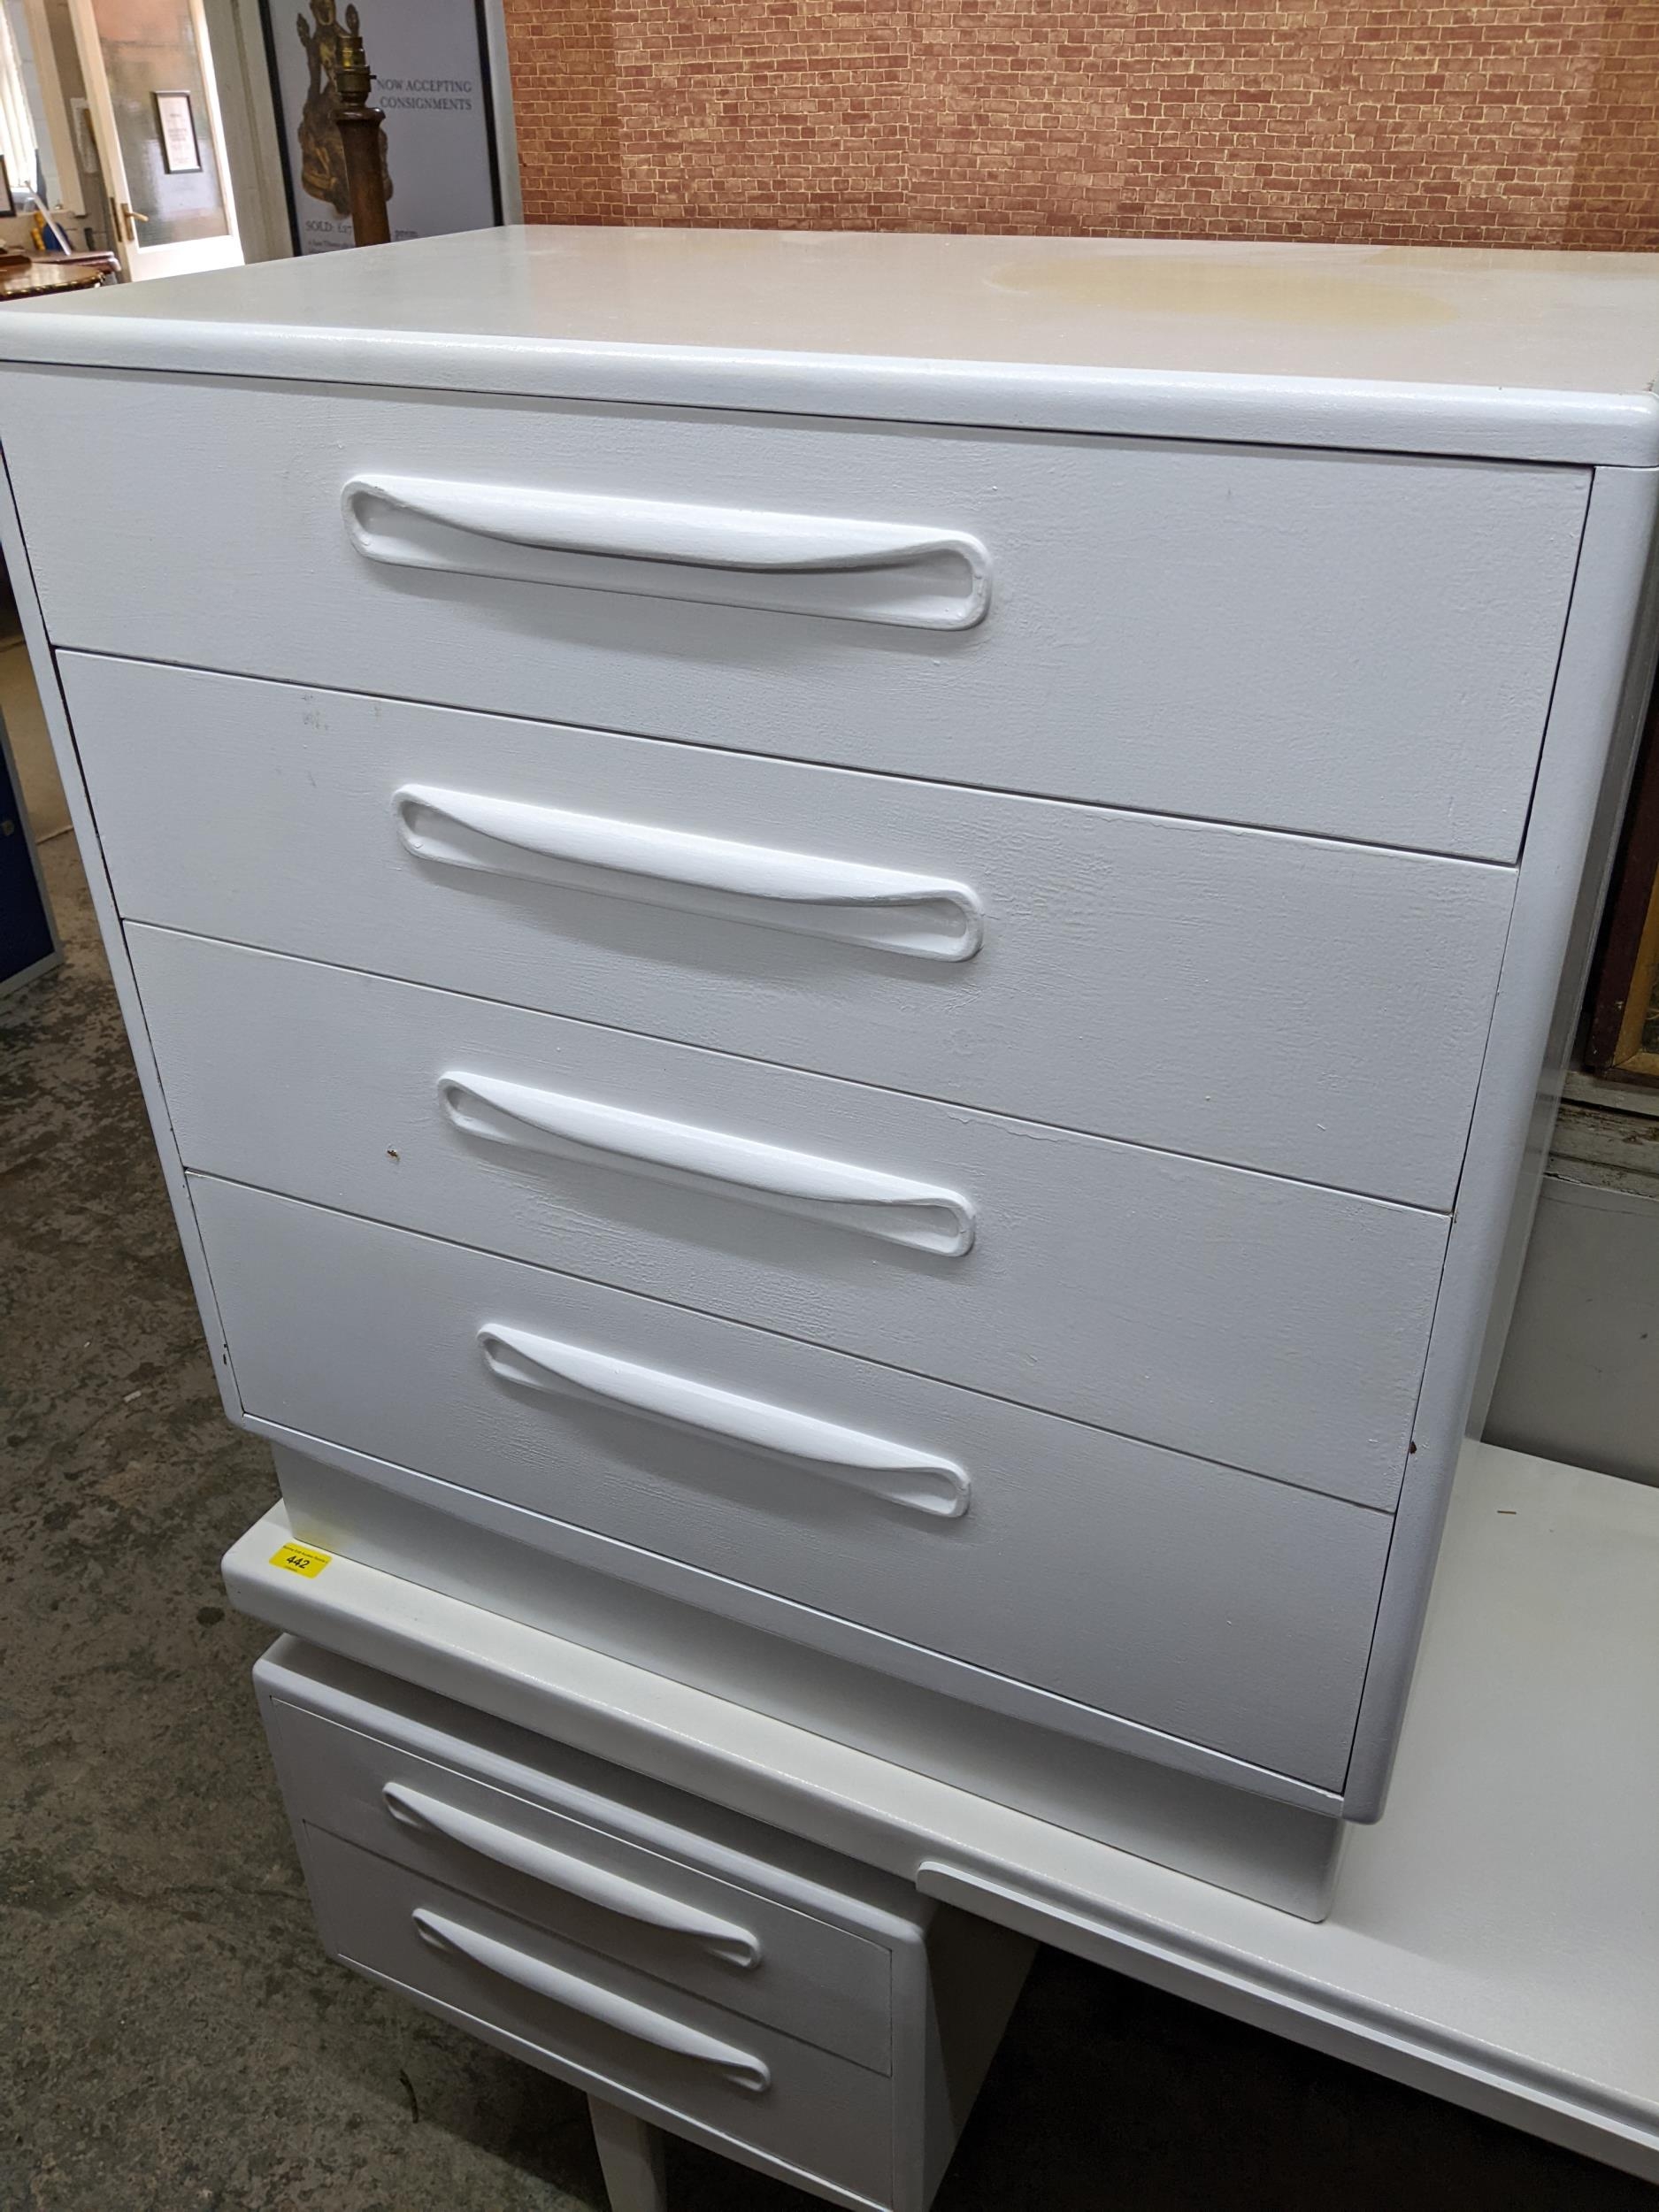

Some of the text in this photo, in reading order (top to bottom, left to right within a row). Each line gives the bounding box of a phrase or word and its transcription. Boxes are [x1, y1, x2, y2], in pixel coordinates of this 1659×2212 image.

[376, 79, 472, 93] NOW ACCEPTING
[380, 96, 472, 111] CONSIGNMENTS
[287, 1555, 311, 1569] 442
